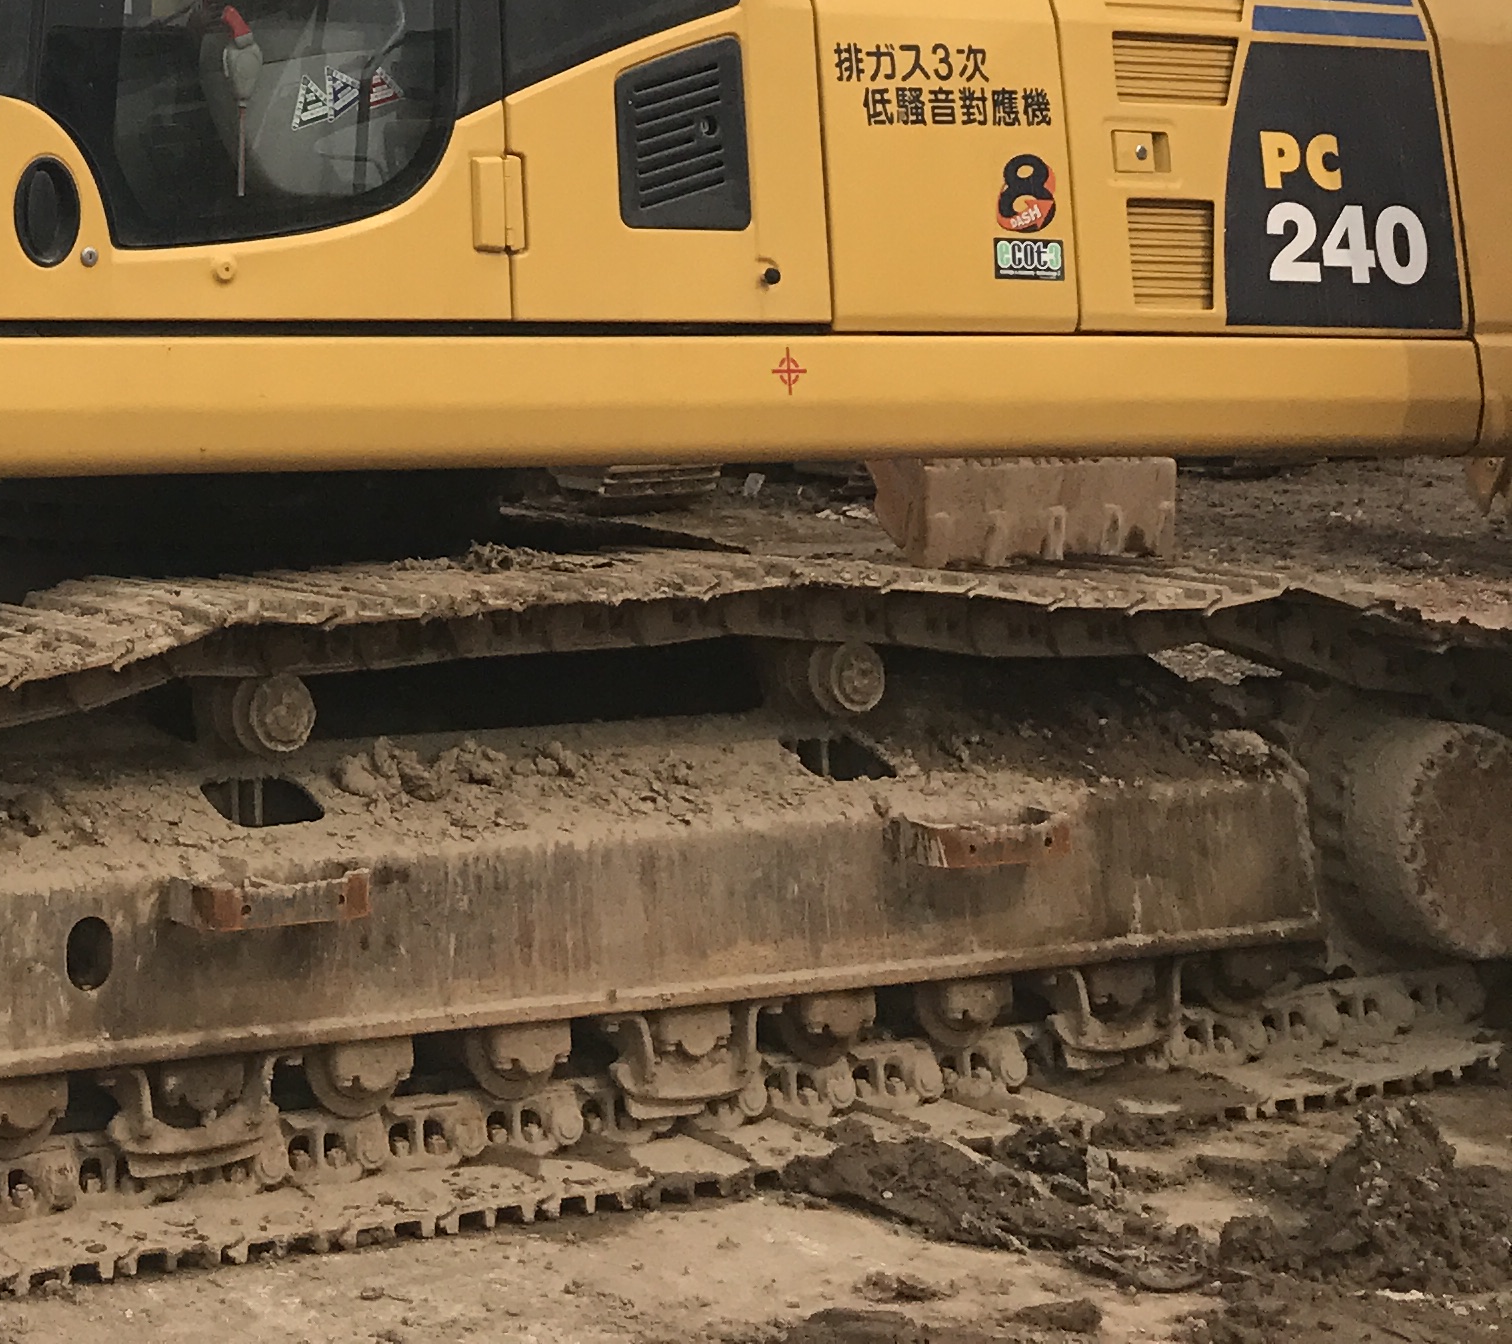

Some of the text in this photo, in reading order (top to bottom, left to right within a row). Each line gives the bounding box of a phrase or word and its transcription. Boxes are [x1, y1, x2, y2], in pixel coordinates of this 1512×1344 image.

[834, 42, 990, 83] 排ガス3次
[1260, 130, 1343, 191] PC
[1009, 204, 1043, 229] DASH
[996, 240, 1062, 270] ecot3
[1266, 201, 1429, 286] 240
